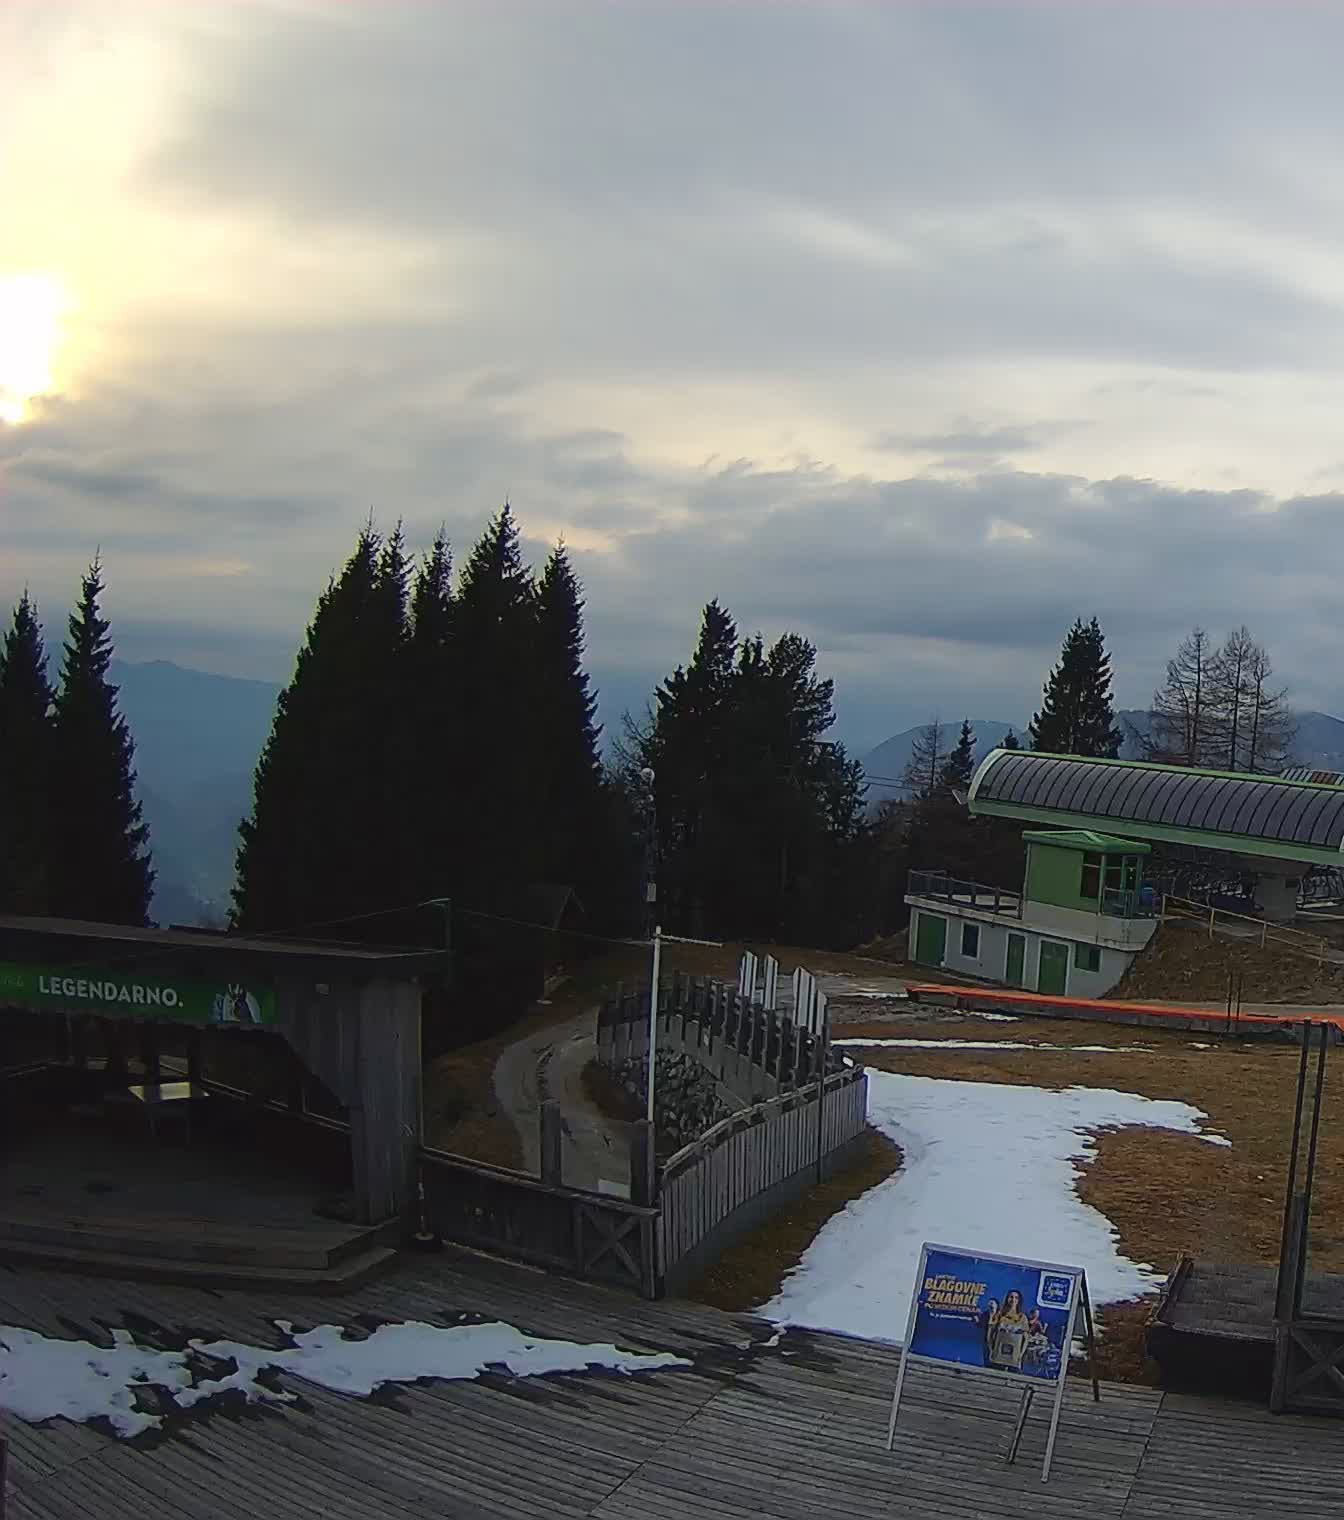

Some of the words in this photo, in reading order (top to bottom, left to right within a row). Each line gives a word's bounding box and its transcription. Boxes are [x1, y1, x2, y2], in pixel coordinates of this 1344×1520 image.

[39, 975, 185, 1008] LEGENDARNO.
[924, 1277, 987, 1295] BLAGOVNE
[927, 1291, 981, 1307] ZNAMKE
